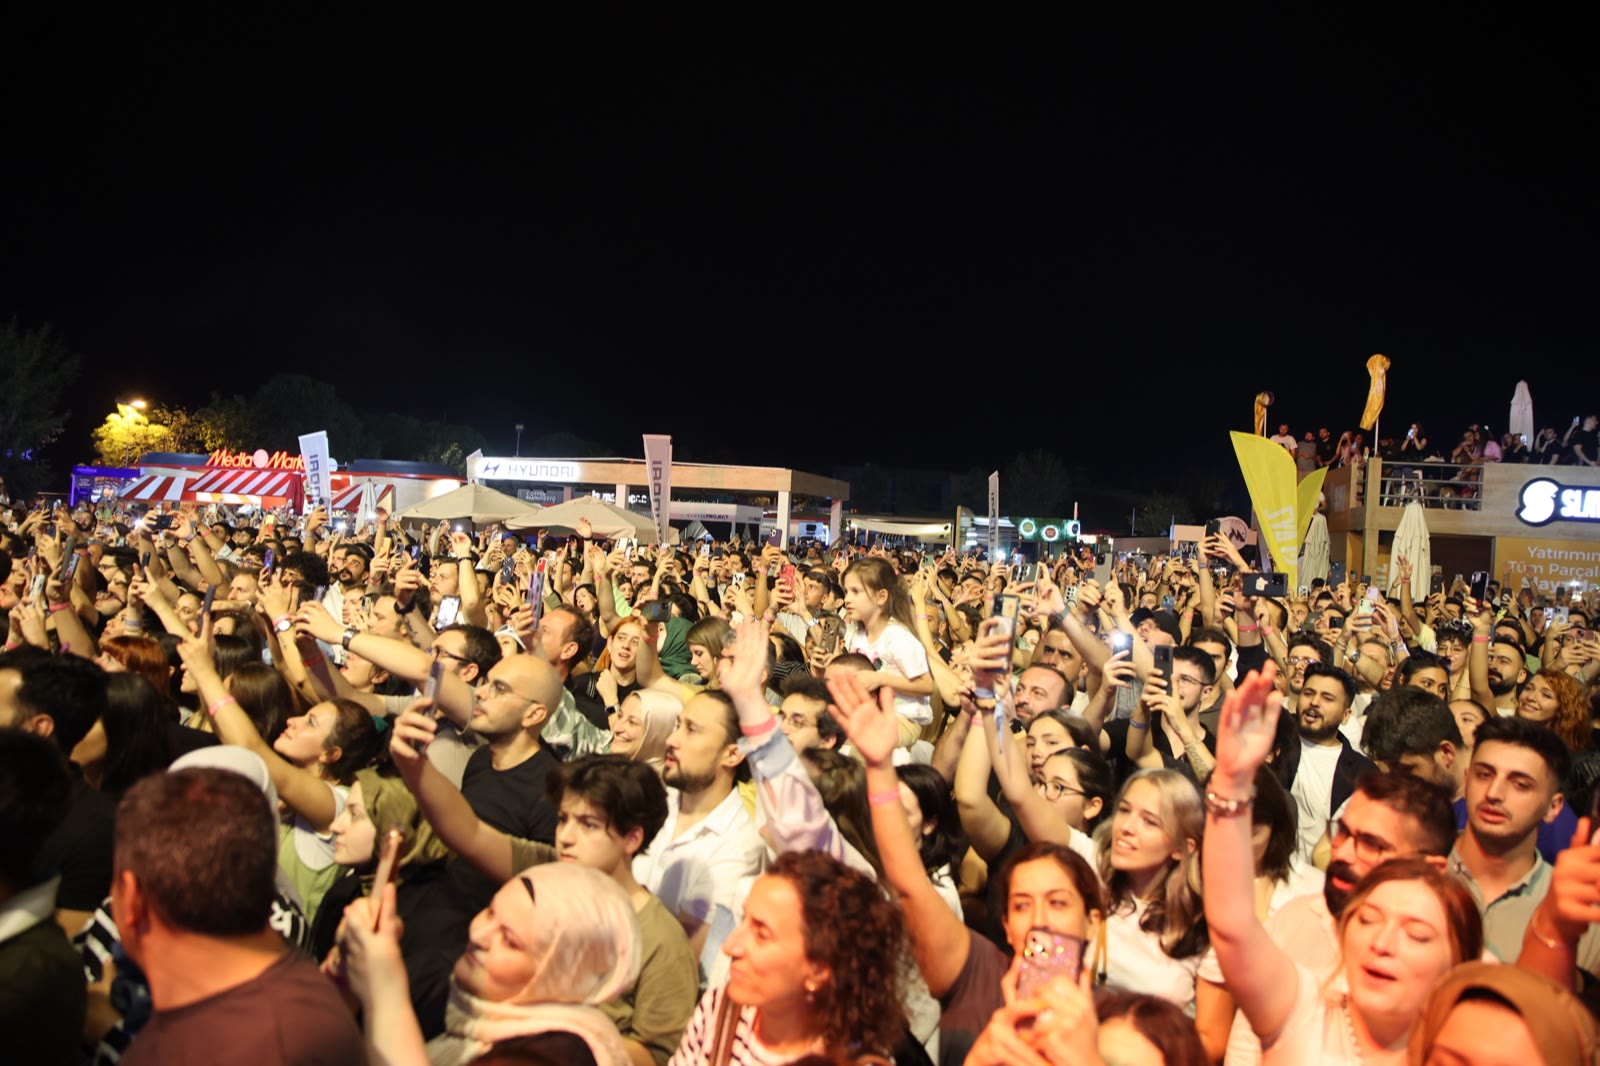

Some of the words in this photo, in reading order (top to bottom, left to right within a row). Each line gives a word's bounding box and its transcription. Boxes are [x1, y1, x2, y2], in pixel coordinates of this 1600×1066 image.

[206, 449, 253, 468] Media
[266, 451, 305, 469] Mark
[509, 464, 574, 478] HYUNDAI
